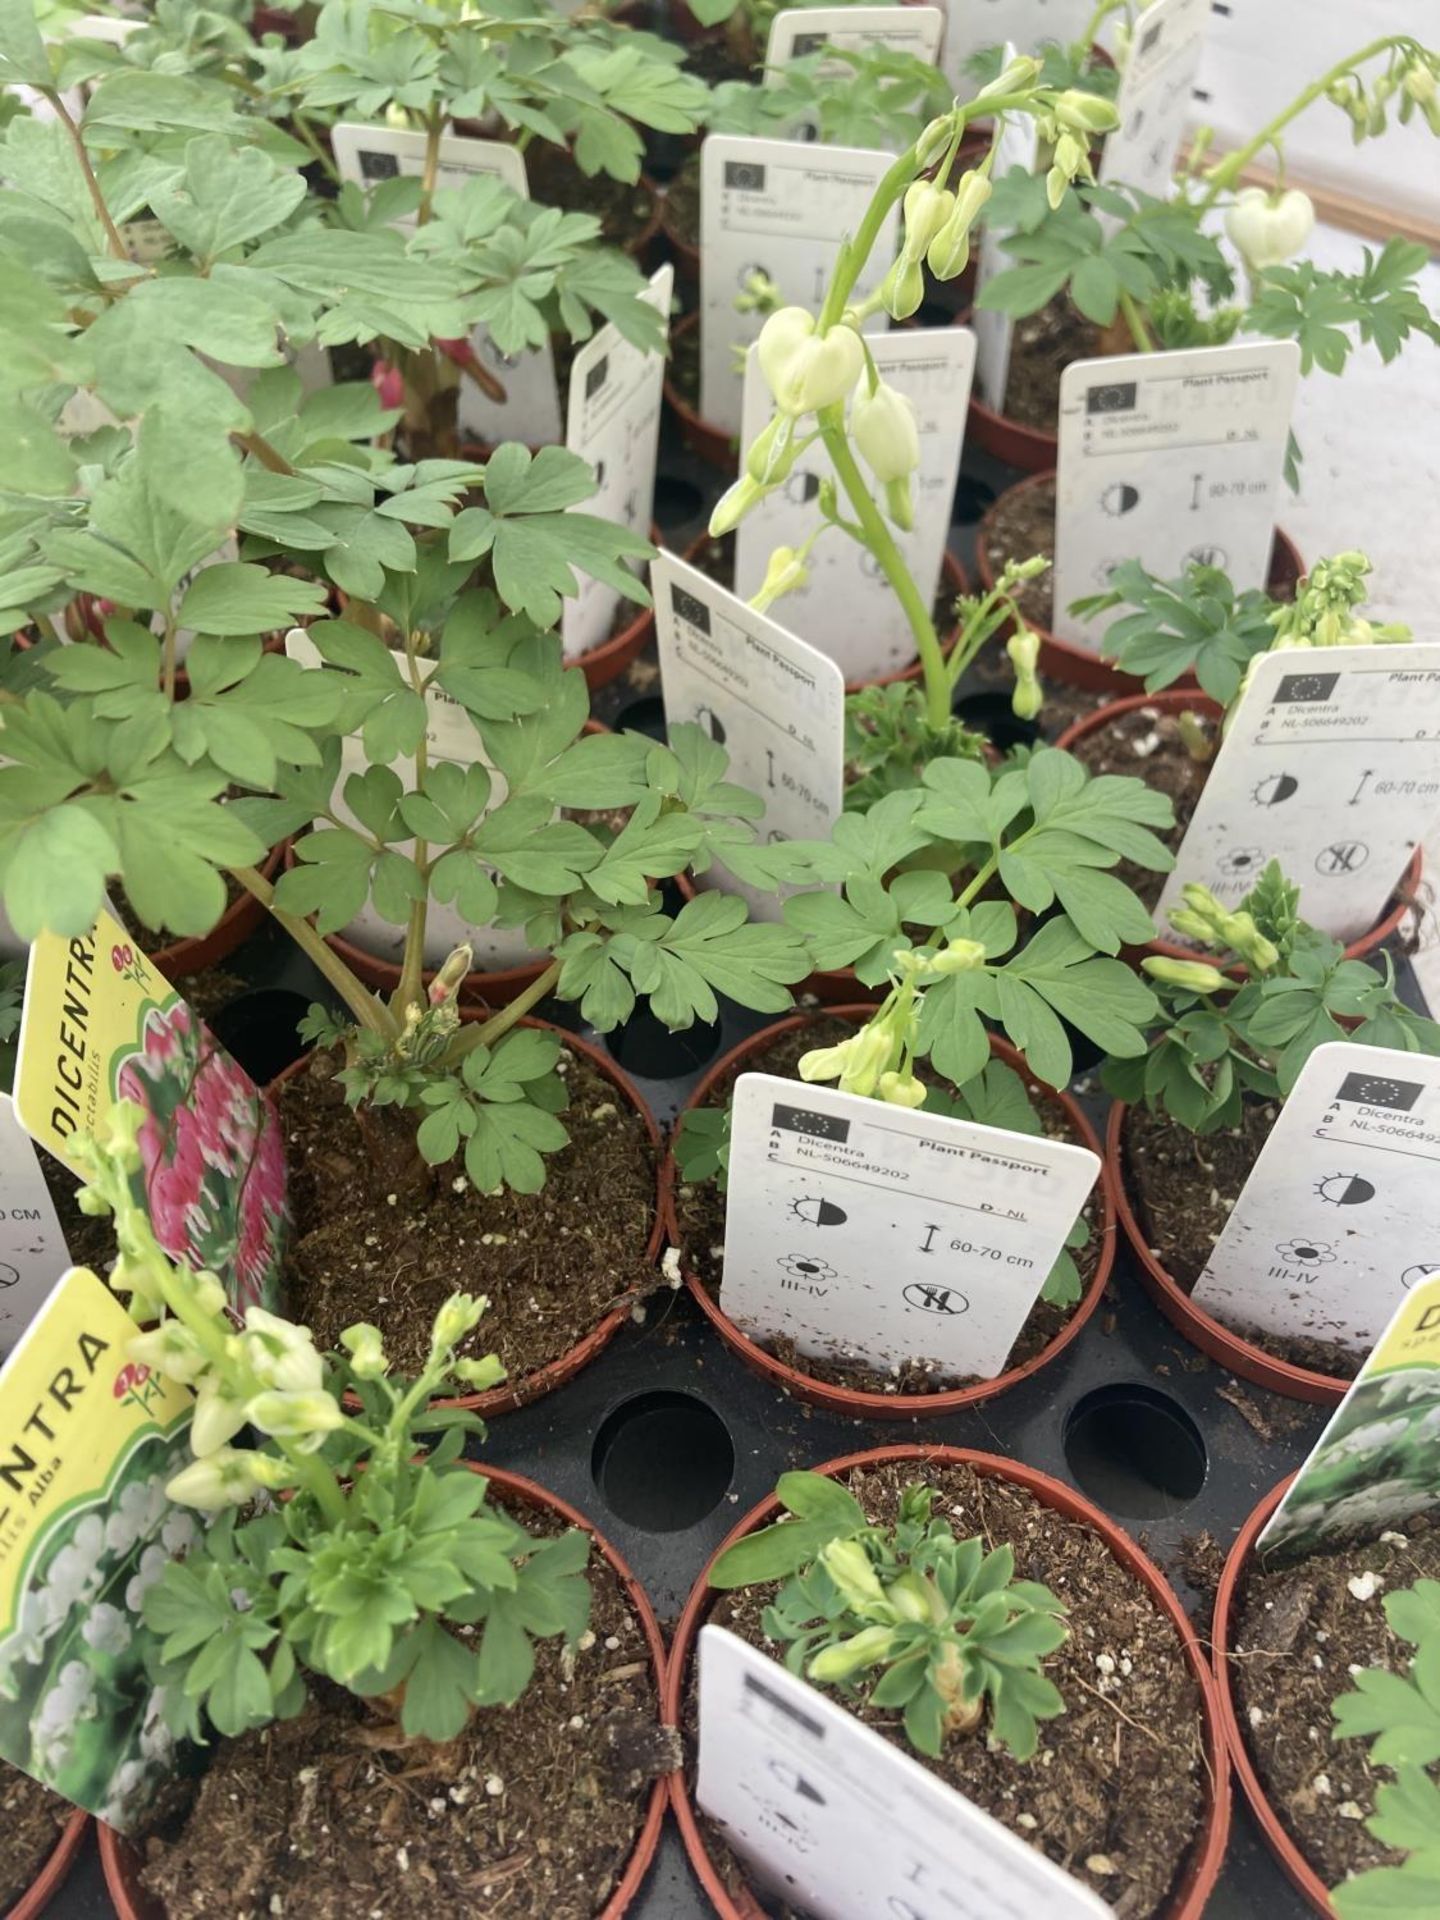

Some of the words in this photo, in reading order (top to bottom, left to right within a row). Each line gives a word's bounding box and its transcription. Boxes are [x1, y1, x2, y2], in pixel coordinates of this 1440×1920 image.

[1182, 376, 1213, 388] Plant
[1216, 371, 1269, 385] Passport
[745, 635, 772, 660] Plant
[773, 654, 816, 690] Passport
[1388, 673, 1423, 682] Plant
[1265, 707, 1275, 716] A
[1287, 705, 1340, 715] Dicentra
[1260, 721, 1270, 730] B
[1281, 716, 1369, 729] NL-506649202
[1255, 734, 1264, 744] C
[1374, 781, 1415, 795] 60-70
[1417, 780, 1440, 794] cm
[1322, 1114, 1335, 1124] B
[1328, 1102, 1341, 1112] A
[1356, 1106, 1426, 1127] Dicentra
[1315, 1128, 1328, 1137] C
[770, 1130, 782, 1139] A
[798, 1136, 866, 1158] Dicentra
[767, 1152, 778, 1161] C
[769, 1141, 780, 1150] B
[797, 1147, 910, 1182] NL-506649202
[919, 1139, 966, 1159] Plant
[969, 1151, 1049, 1177] Passport
[11, 1209, 41, 1220] CM
[979, 1203, 994, 1212] D
[1007, 1209, 1026, 1219] NL
[949, 1238, 1002, 1261] 60-70
[1006, 1255, 1034, 1269] cm
[1267, 1266, 1319, 1285] III-IV
[781, 1279, 829, 1297] III-IV
[28, 1456, 62, 1509] Alba
